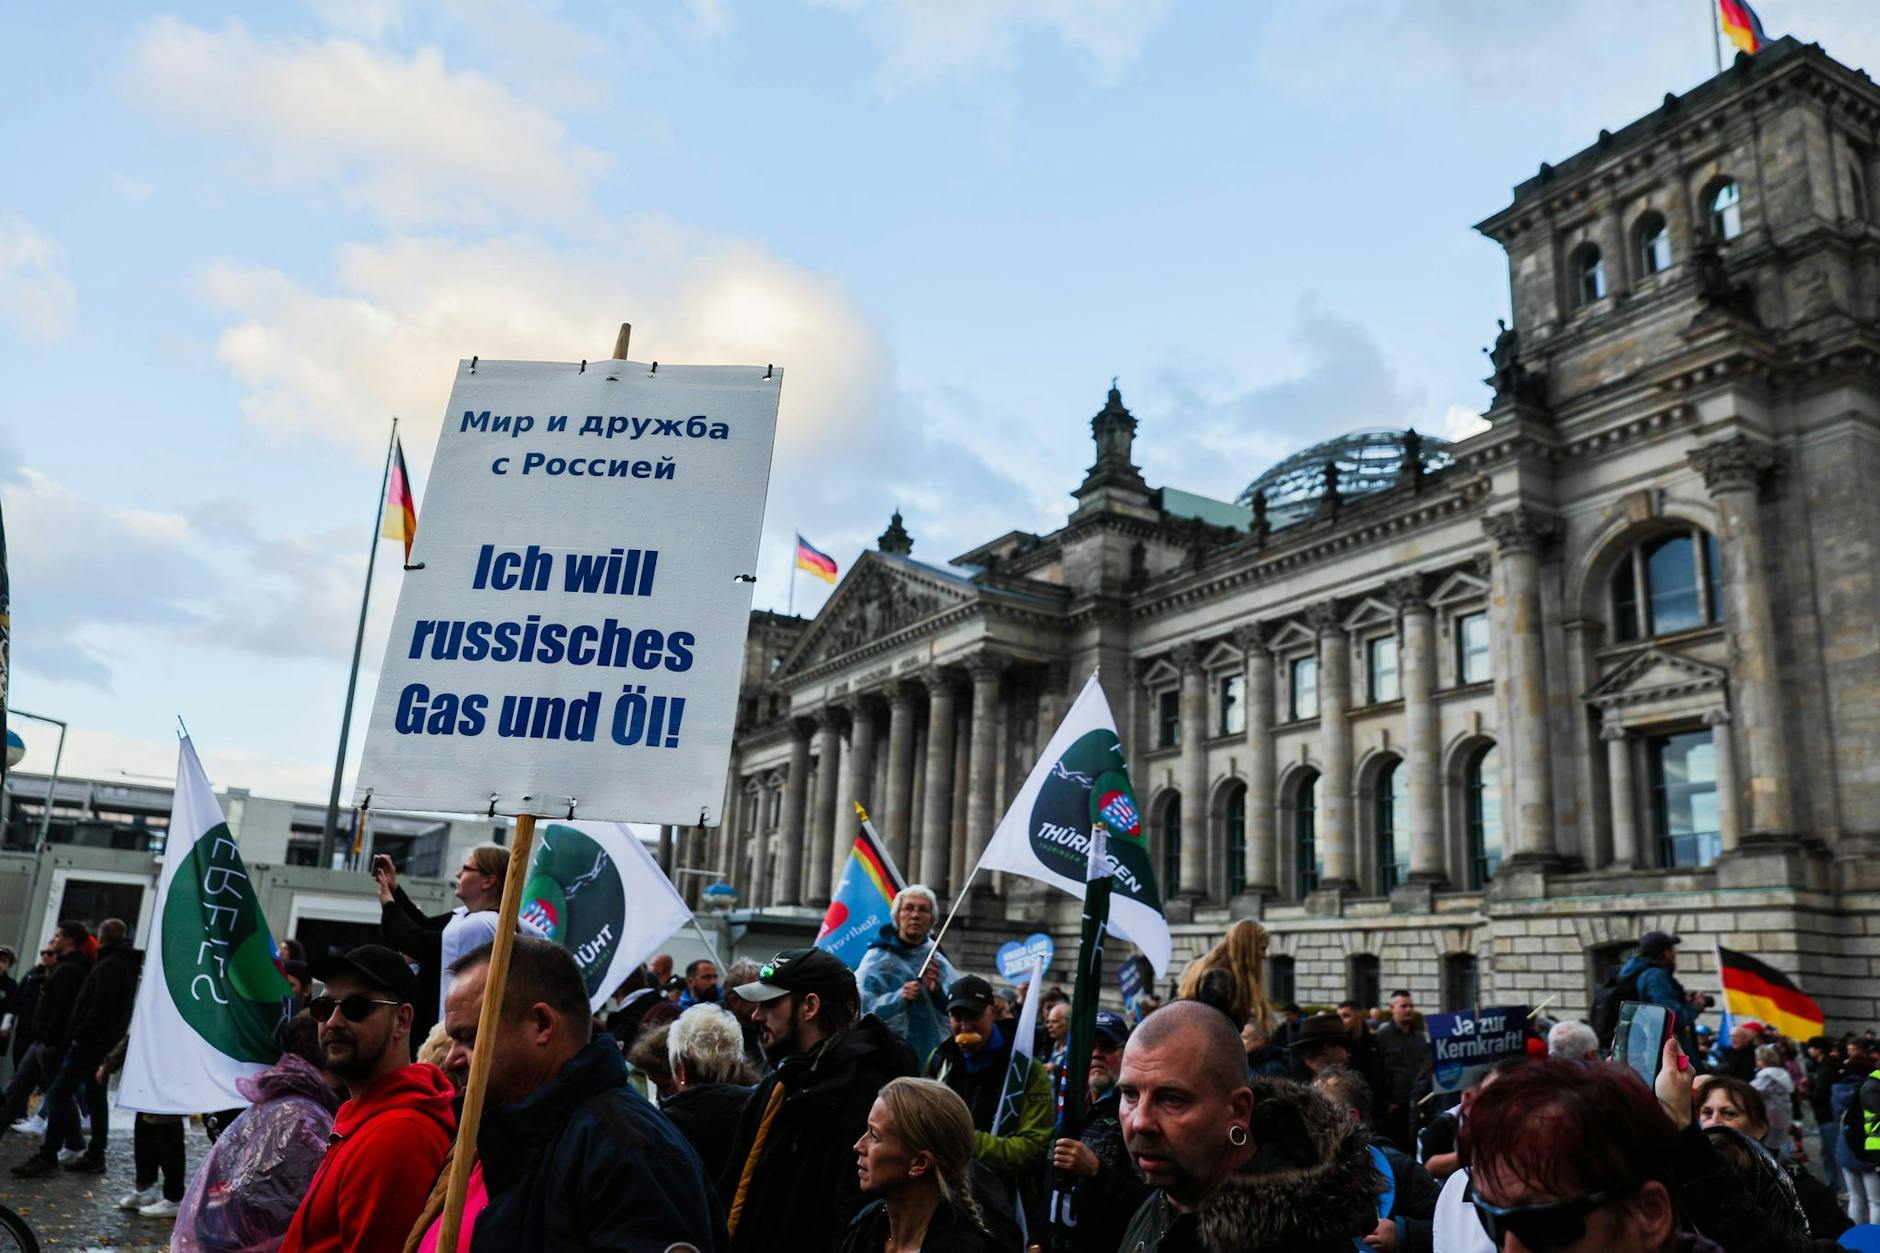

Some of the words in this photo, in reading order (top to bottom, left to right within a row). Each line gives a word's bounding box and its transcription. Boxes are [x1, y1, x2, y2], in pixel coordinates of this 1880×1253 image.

[460, 411, 534, 438] Мир
[547, 416, 567, 432] и
[579, 416, 729, 440] дружба
[492, 458, 510, 475] с
[522, 453, 676, 480] Россией
[473, 544, 553, 591] Ich
[564, 548, 658, 596] will
[408, 615, 695, 672] russisches
[395, 683, 488, 736] Gas
[498, 691, 602, 742] und
[611, 684, 686, 748] Öl!
[1451, 1015, 1475, 1036] Ja
[1479, 1016, 1506, 1034] zur
[1436, 1030, 1523, 1060] Kernkraft!
